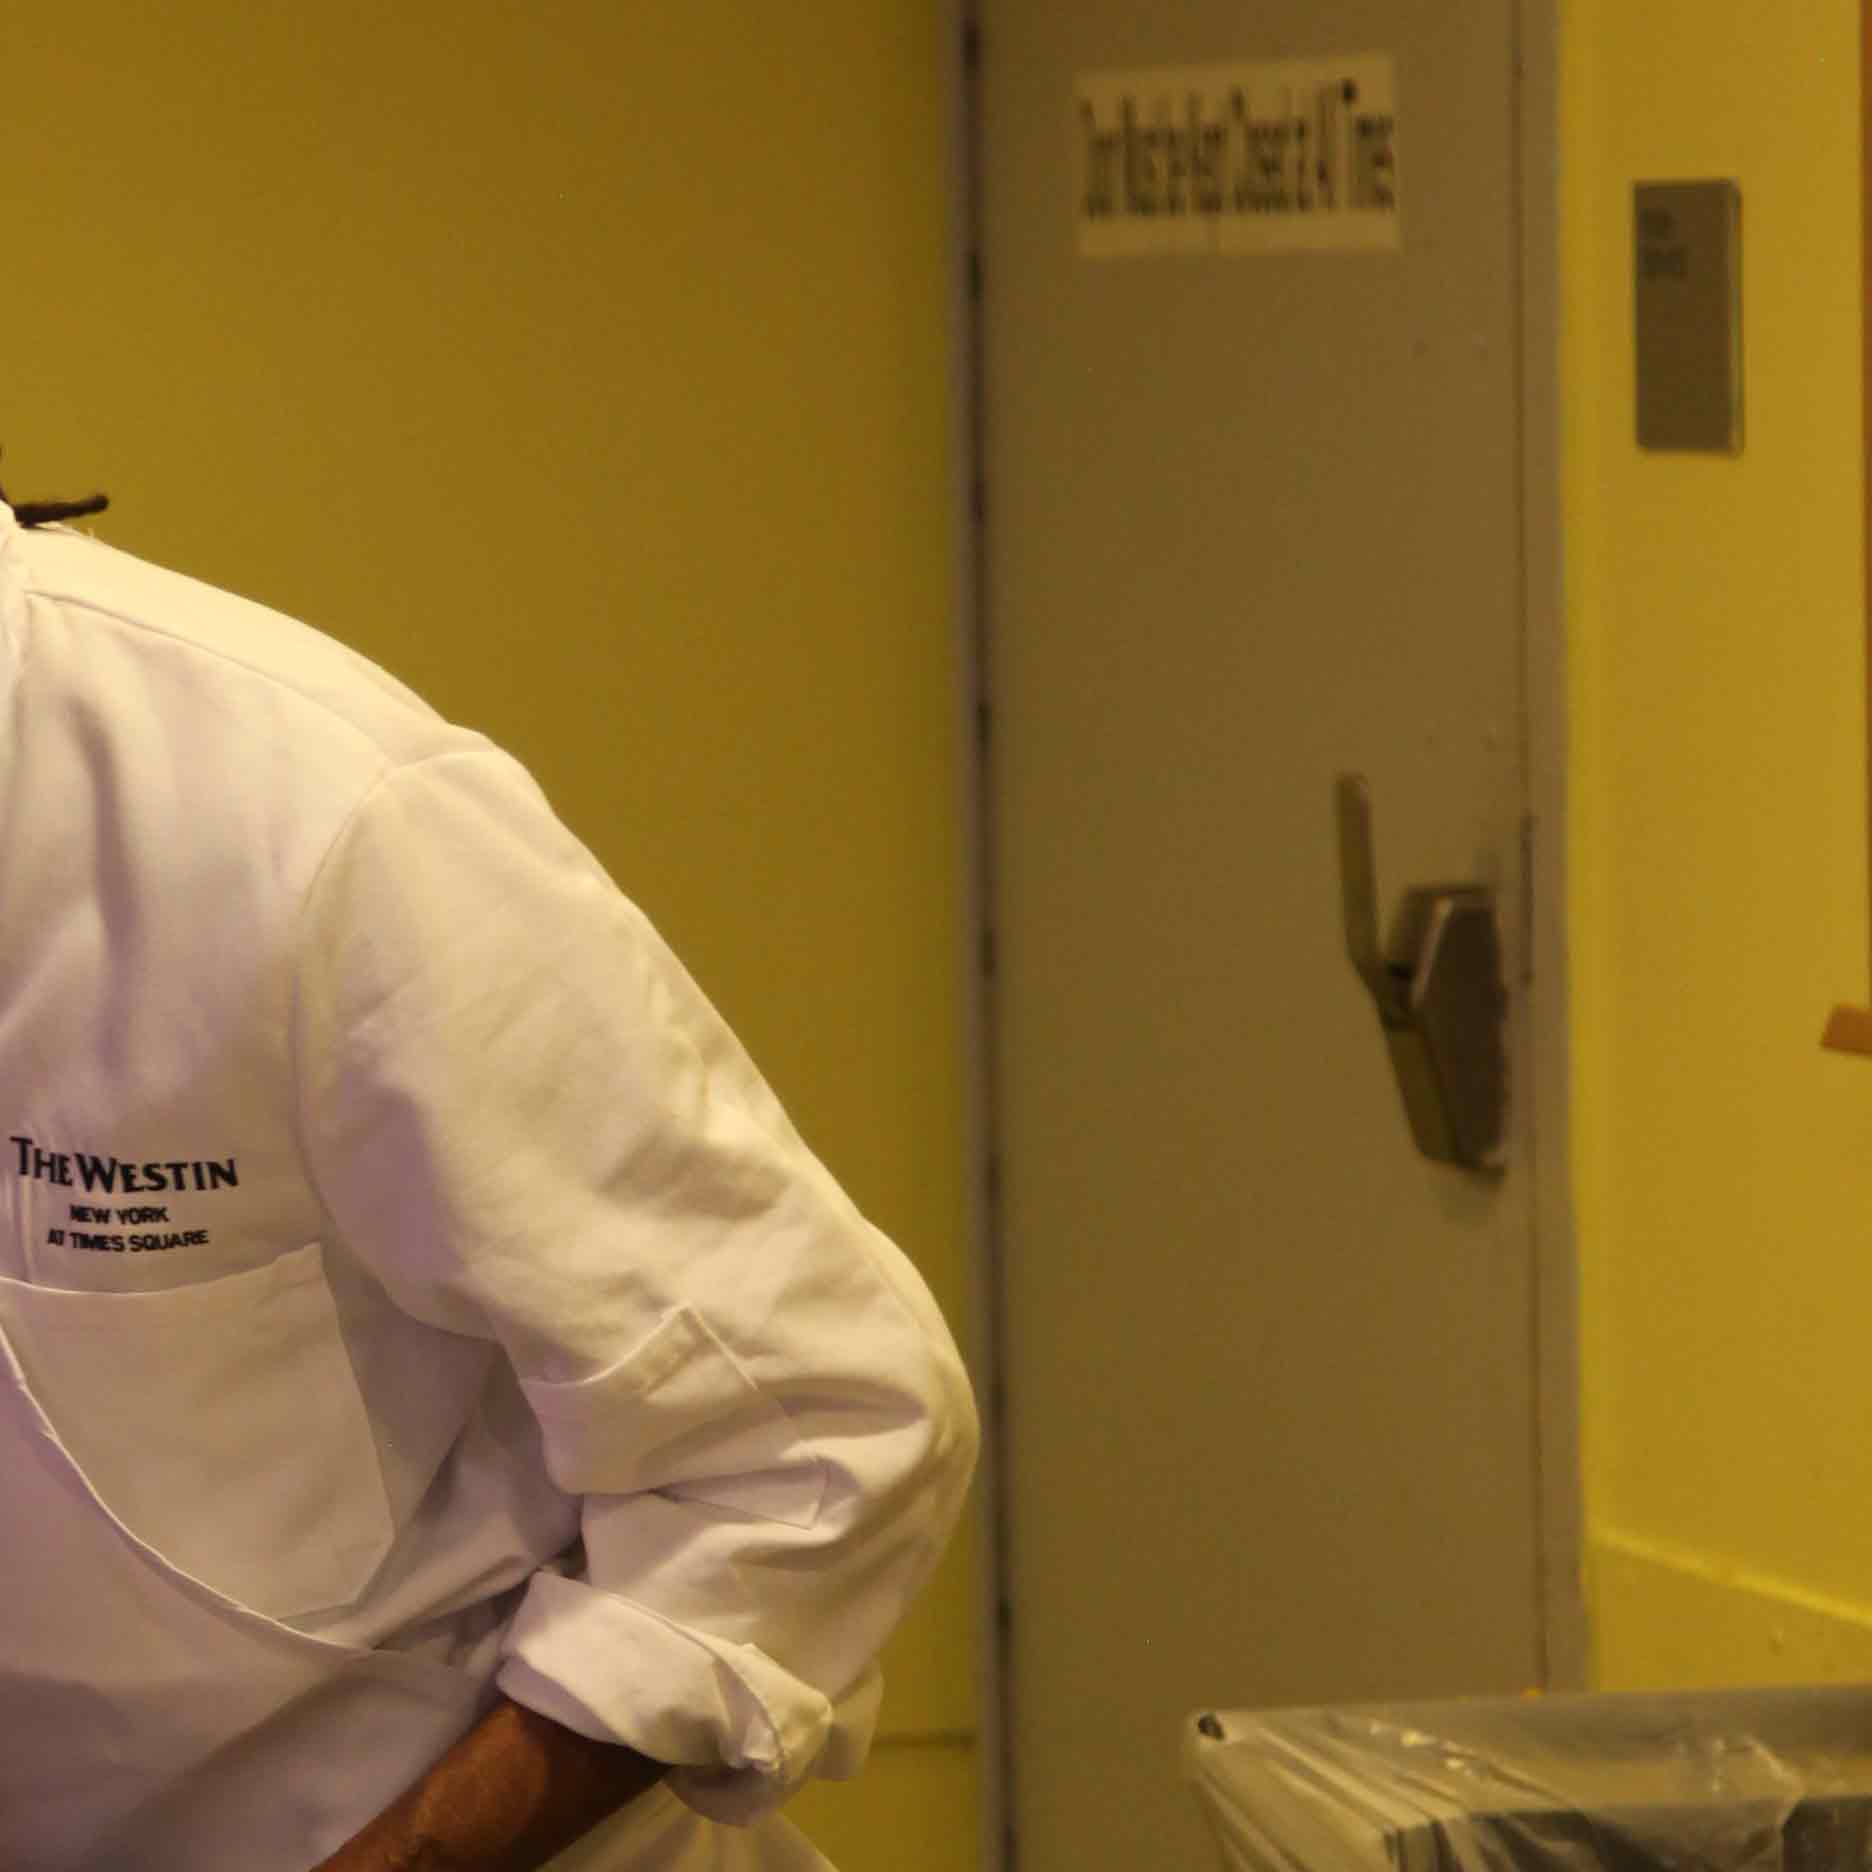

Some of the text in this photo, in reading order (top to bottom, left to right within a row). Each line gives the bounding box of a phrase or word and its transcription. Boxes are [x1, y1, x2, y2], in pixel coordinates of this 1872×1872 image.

[10, 1136, 239, 1194] THE WESTIN
[70, 1205, 170, 1225] NEW YORK
[48, 1229, 209, 1253] AT TIMES SQUARE
